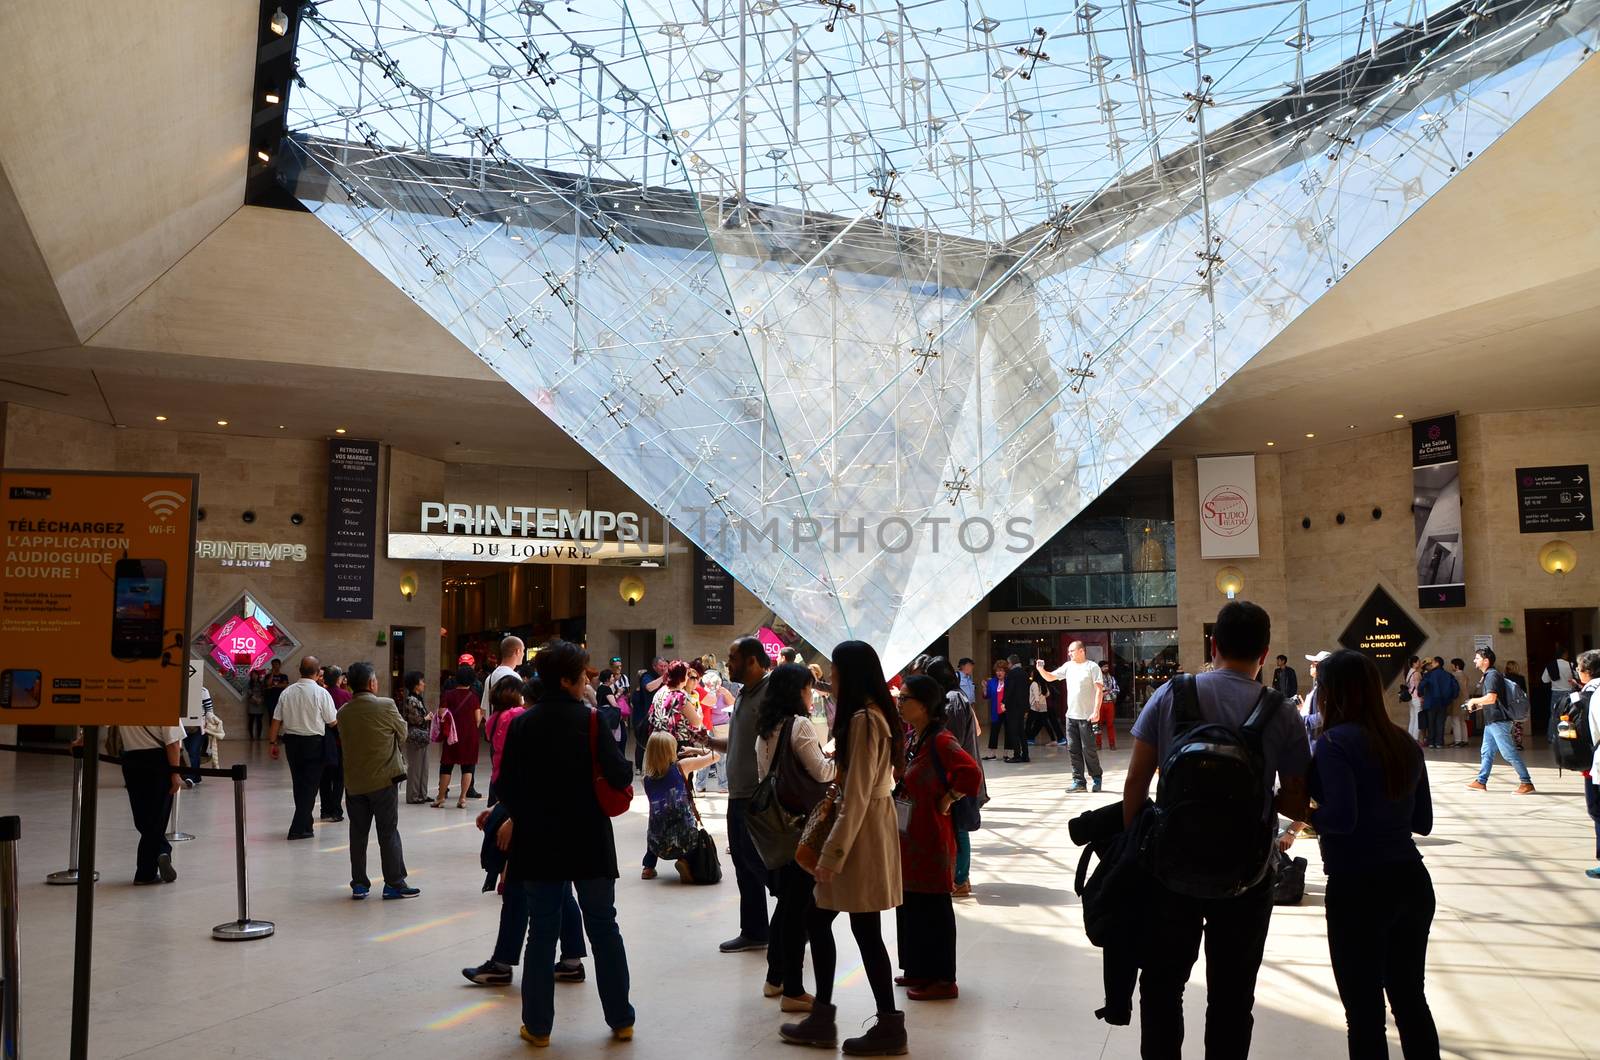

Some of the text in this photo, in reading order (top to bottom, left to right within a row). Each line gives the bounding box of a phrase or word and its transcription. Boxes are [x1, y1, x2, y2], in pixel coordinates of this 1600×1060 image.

[1426, 444, 1451, 454] Carrousel
[1204, 502, 1245, 519] STUDIO
[8, 519, 125, 534] TÉLÉCHARGEZ
[420, 501, 639, 541] PRINTEMPS
[149, 525, 177, 534] Wi-Fi
[6, 551, 113, 564] AUDIOGUIDE
[195, 541, 307, 562] RINTEMPS
[472, 542, 592, 559] DU LOUVRE
[5, 566, 71, 579] LOUVRE
[1011, 614, 1070, 625] COMÉDIE
[1085, 613, 1157, 626] FRANÇAISE
